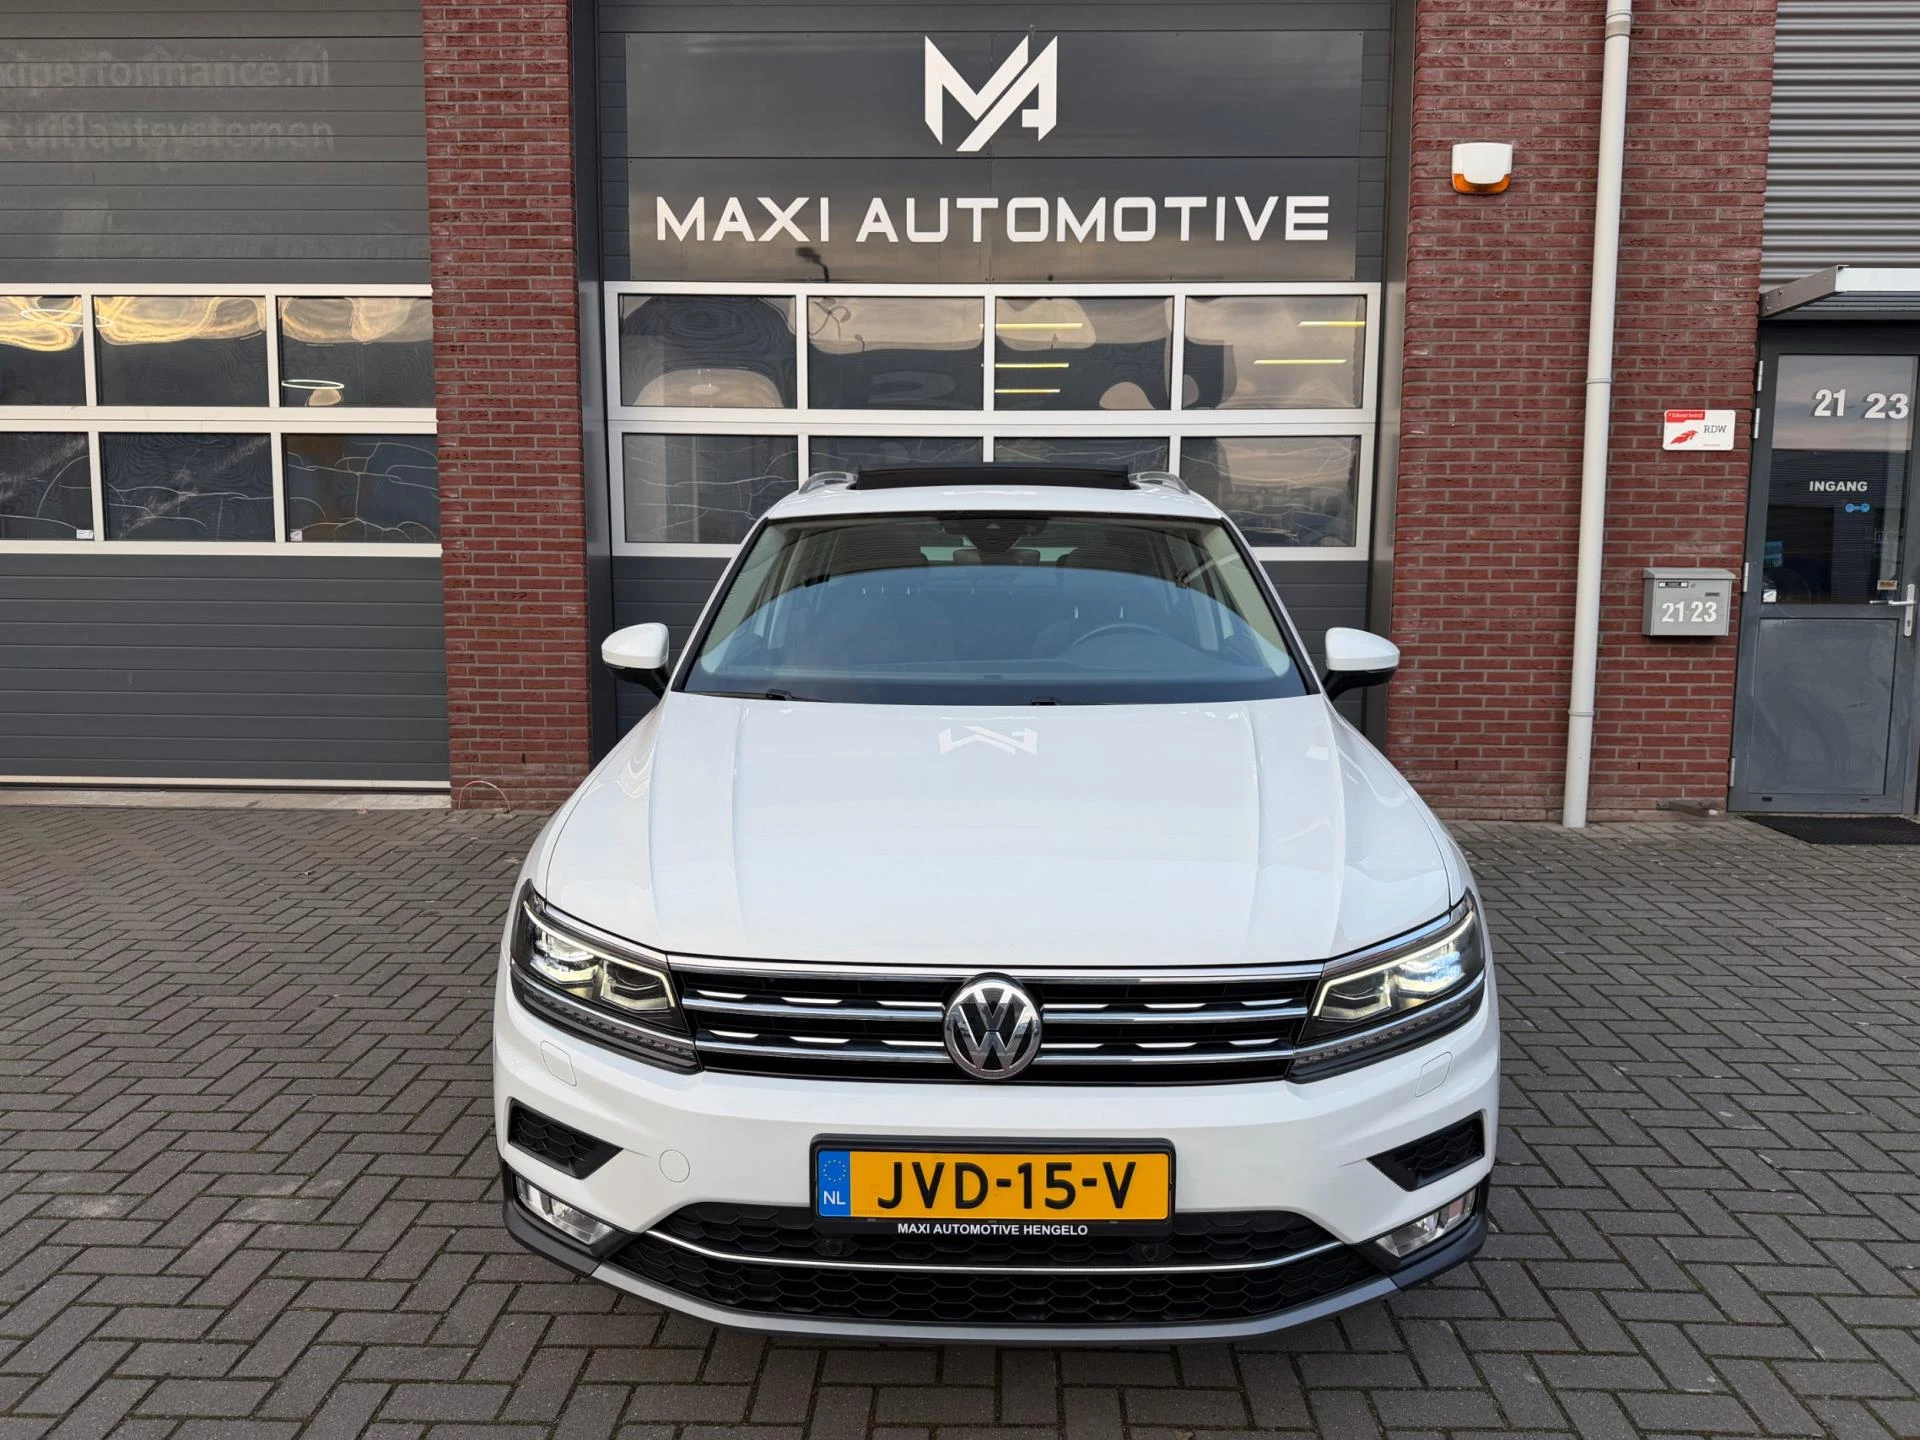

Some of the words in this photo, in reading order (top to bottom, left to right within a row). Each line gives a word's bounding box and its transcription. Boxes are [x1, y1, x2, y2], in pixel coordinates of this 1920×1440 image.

[656, 197, 830, 243] MAXI
[856, 196, 1330, 243] AUTOMOTIVE
[1814, 389, 1846, 417] 21
[1864, 393, 1909, 419] 23
[1704, 425, 1727, 434] RDW
[1809, 481, 1868, 492] INGANG
[1661, 601, 1685, 622] 21
[1690, 601, 1718, 623] 23
[877, 1162, 1137, 1210] JVD-15-V
[823, 1190, 846, 1205] NL
[897, 1223, 930, 1234] MAXI
[933, 1223, 1020, 1236] AUTOMOTIVE
[1023, 1224, 1088, 1236] HENGELO
